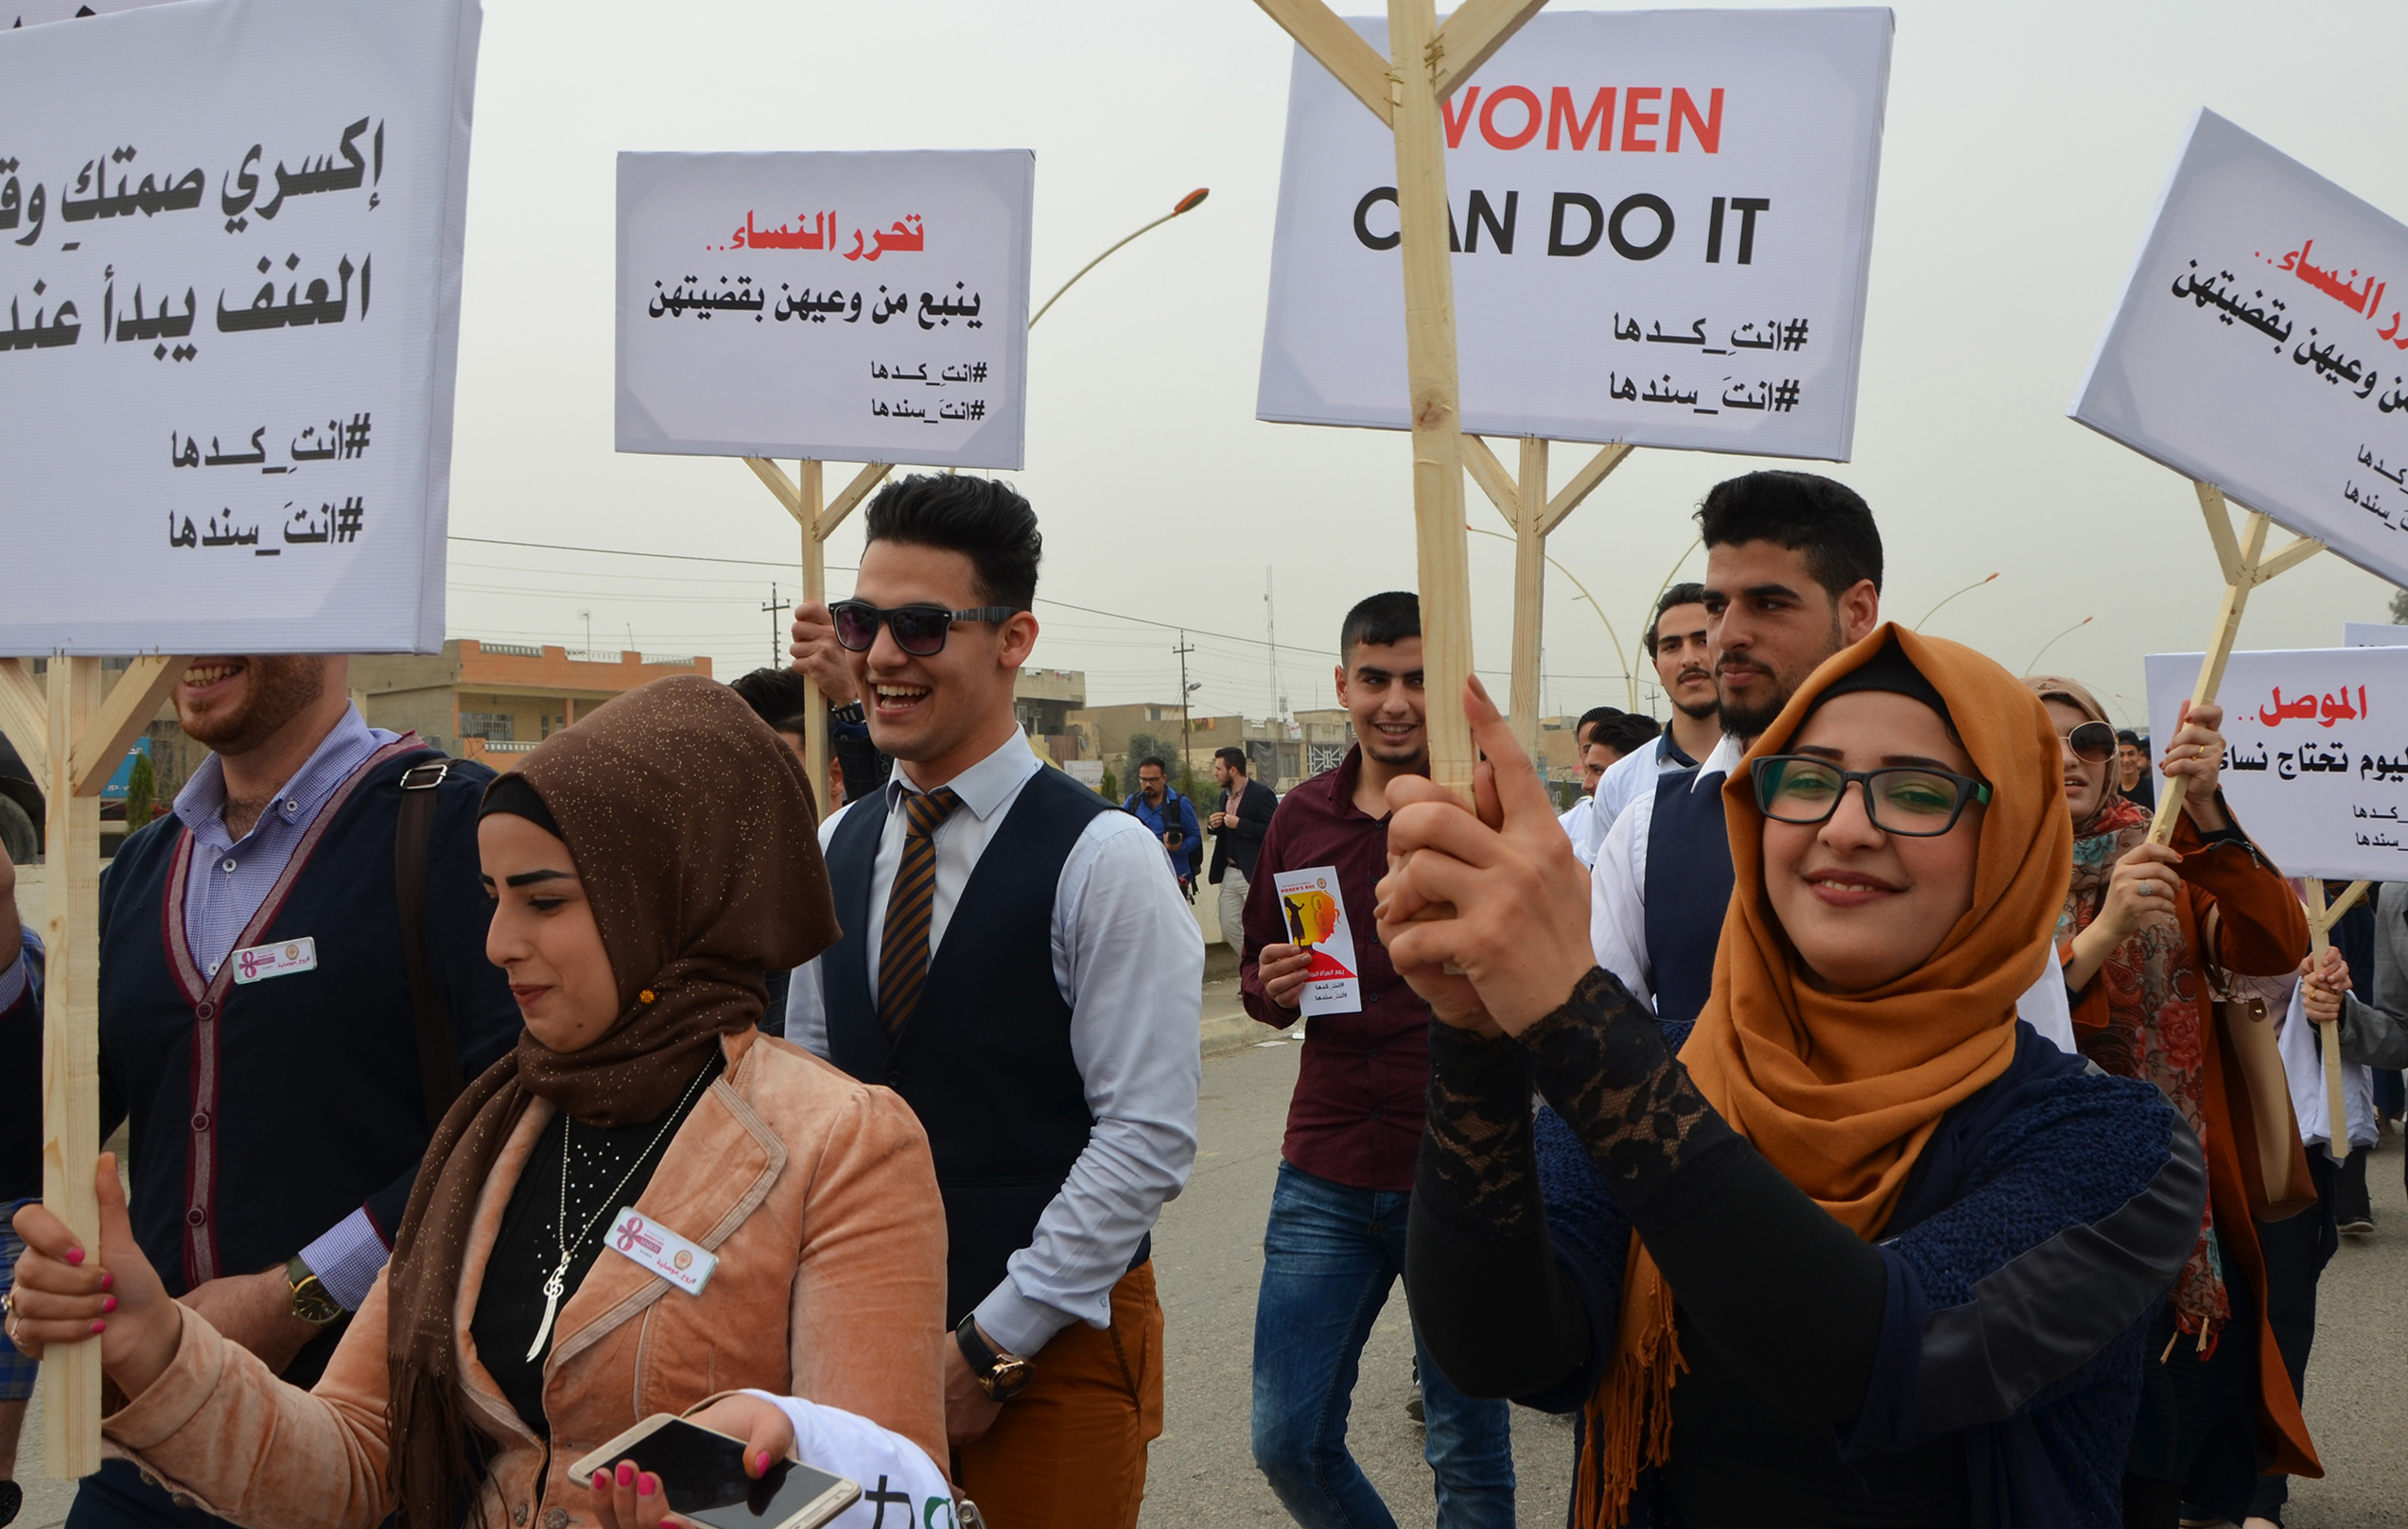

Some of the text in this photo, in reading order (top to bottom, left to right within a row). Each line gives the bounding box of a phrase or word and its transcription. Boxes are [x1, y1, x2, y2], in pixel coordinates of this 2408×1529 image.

[0, 157, 45, 247] وق
[221, 116, 384, 235] إكسري
[843, 213, 925, 262] تحرر
[1353, 186, 1771, 265] CN DO IT
[104, 264, 198, 362] يبدأ
[216, 252, 371, 333] العنف
[648, 275, 983, 331] ينبع من وعيهن بقضيتهن
[2171, 259, 2295, 355] بقضيتهن
[2293, 327, 2379, 400] وعيهن
[2277, 742, 2348, 781] تحتاج
